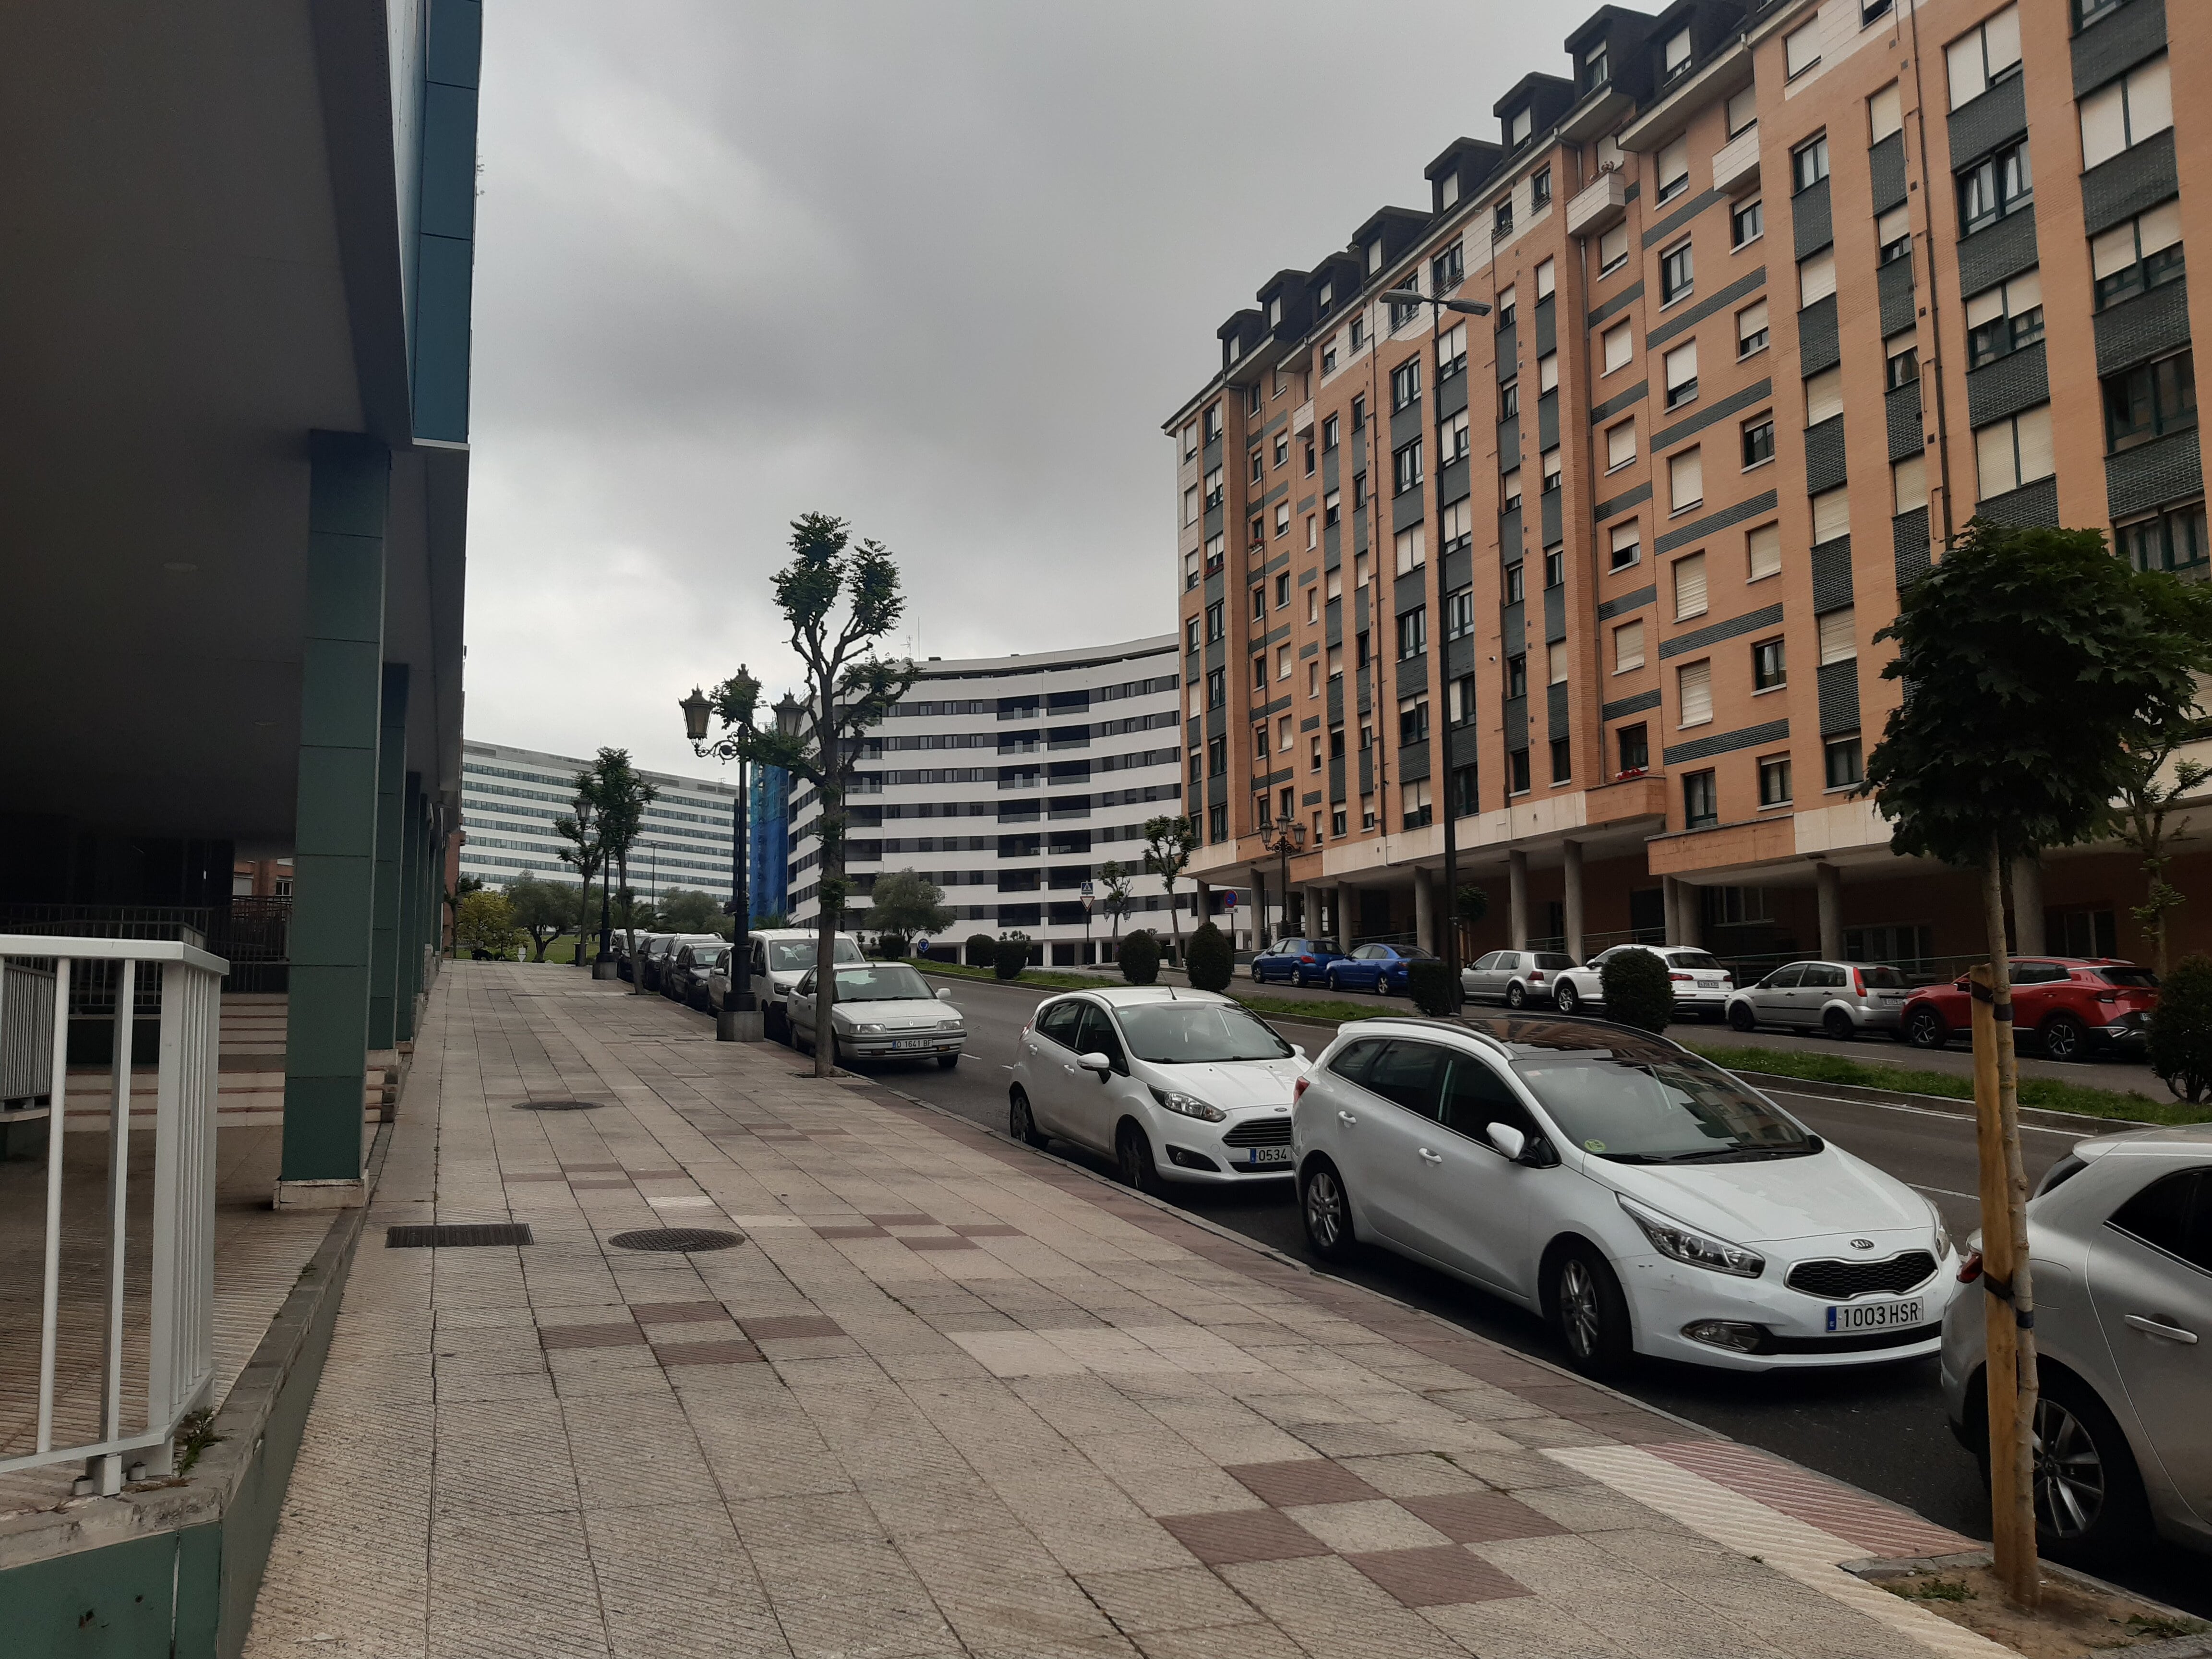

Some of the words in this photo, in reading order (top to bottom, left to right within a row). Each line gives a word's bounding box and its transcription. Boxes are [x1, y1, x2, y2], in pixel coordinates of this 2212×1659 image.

[1259, 1148, 1286, 1161] 0534
[1844, 1306, 1886, 1327] 1003
[1890, 1302, 1918, 1323] HSR
